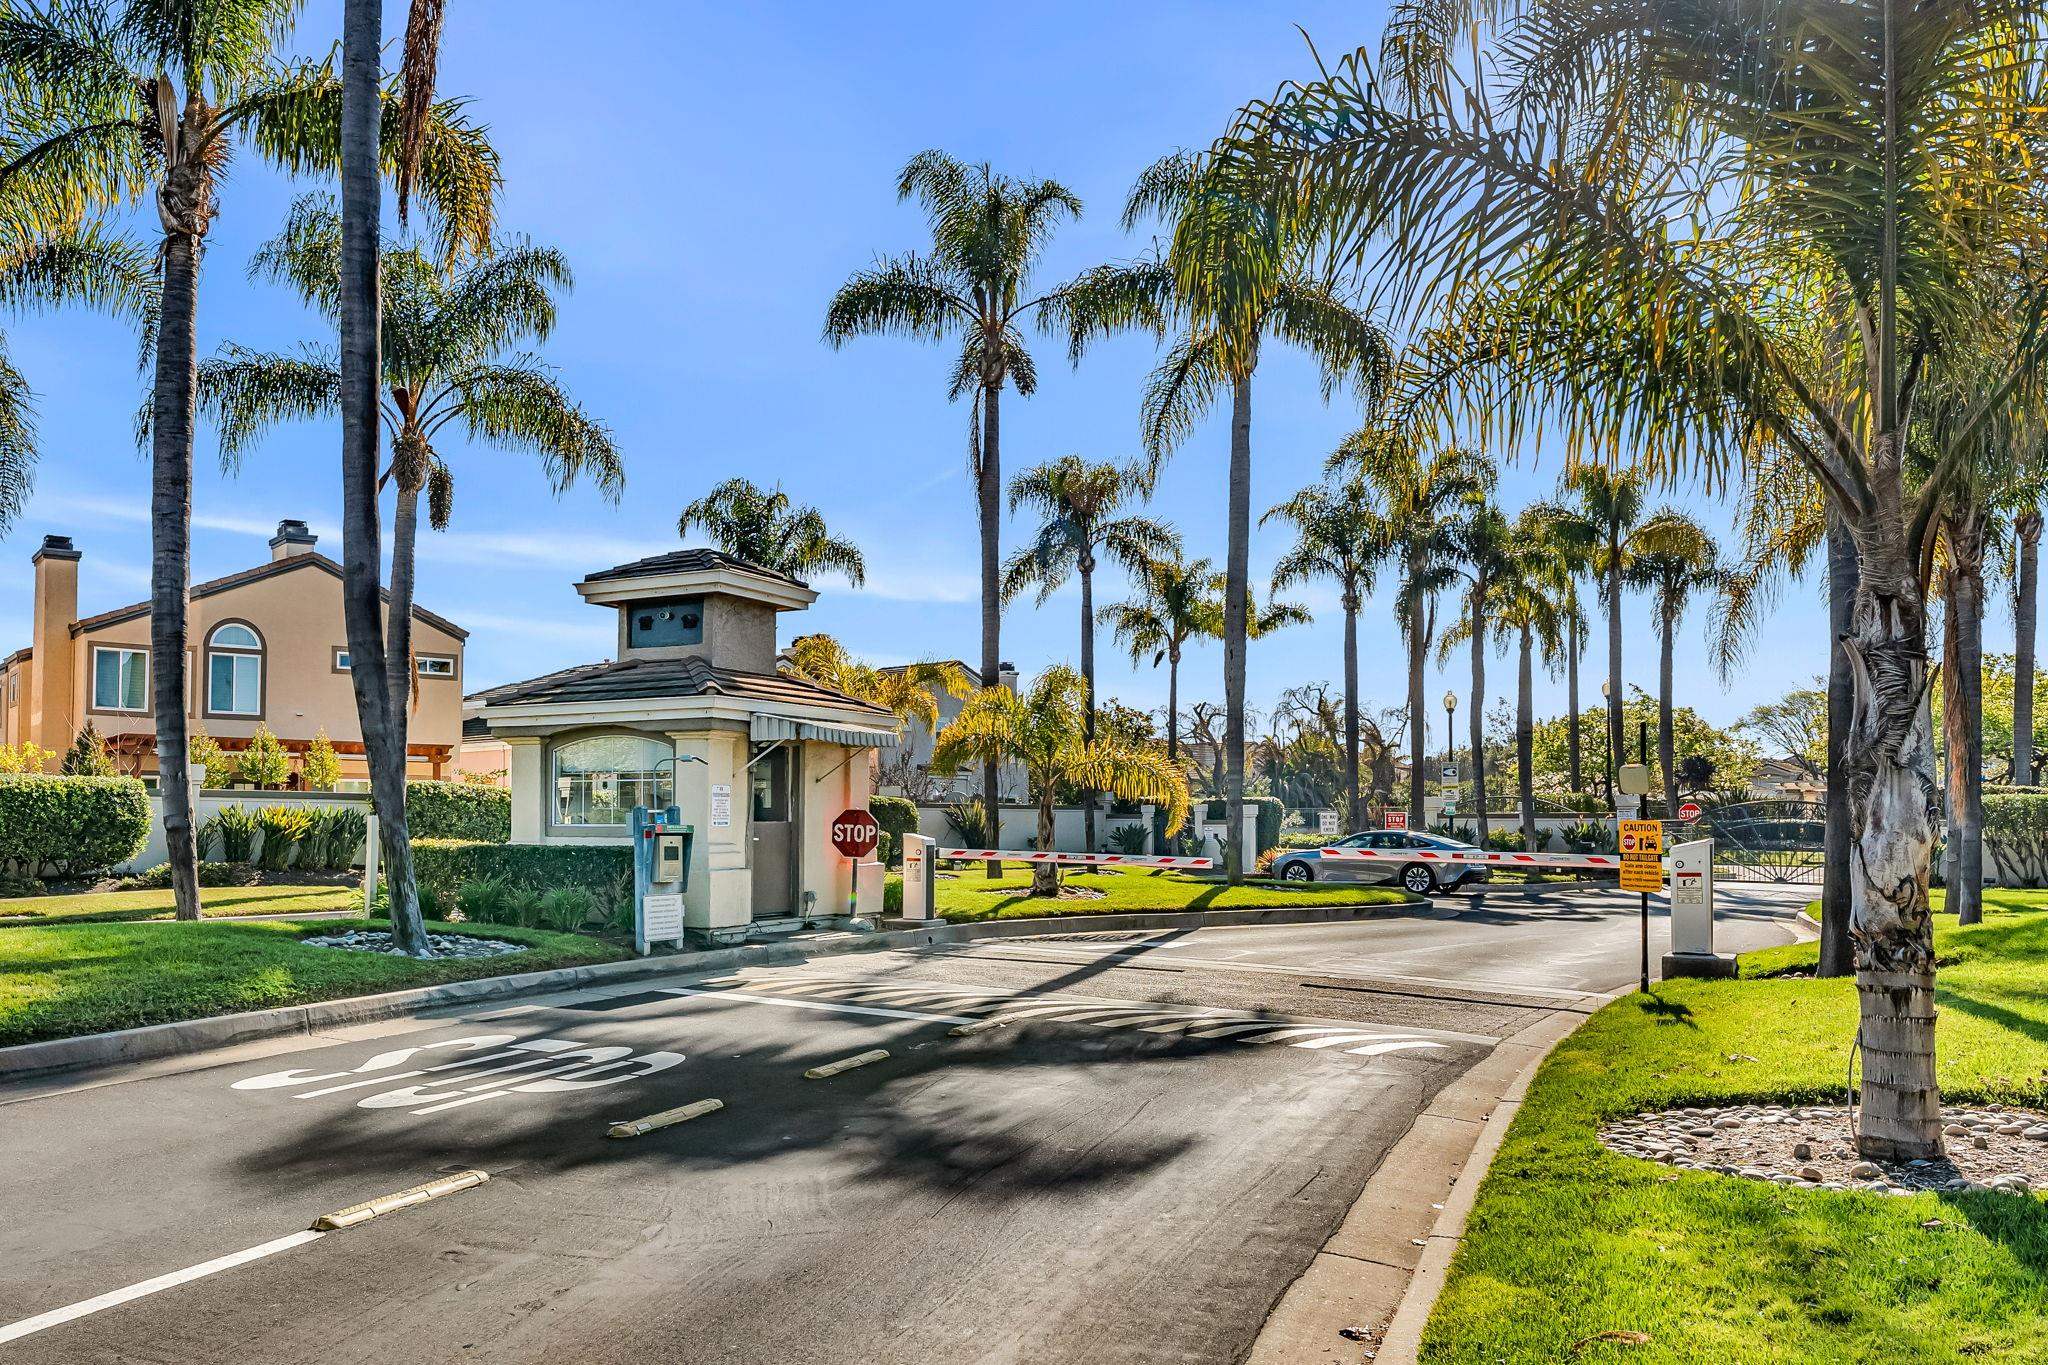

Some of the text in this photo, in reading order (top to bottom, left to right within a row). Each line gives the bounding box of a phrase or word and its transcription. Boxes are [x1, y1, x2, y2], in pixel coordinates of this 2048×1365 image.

[1680, 810, 1700, 818] STOP
[1623, 823, 1658, 832] CAUTION
[833, 824, 876, 843] STOP
[1639, 854, 1659, 862] TAILGATE
[230, 1034, 686, 1116] STOP
